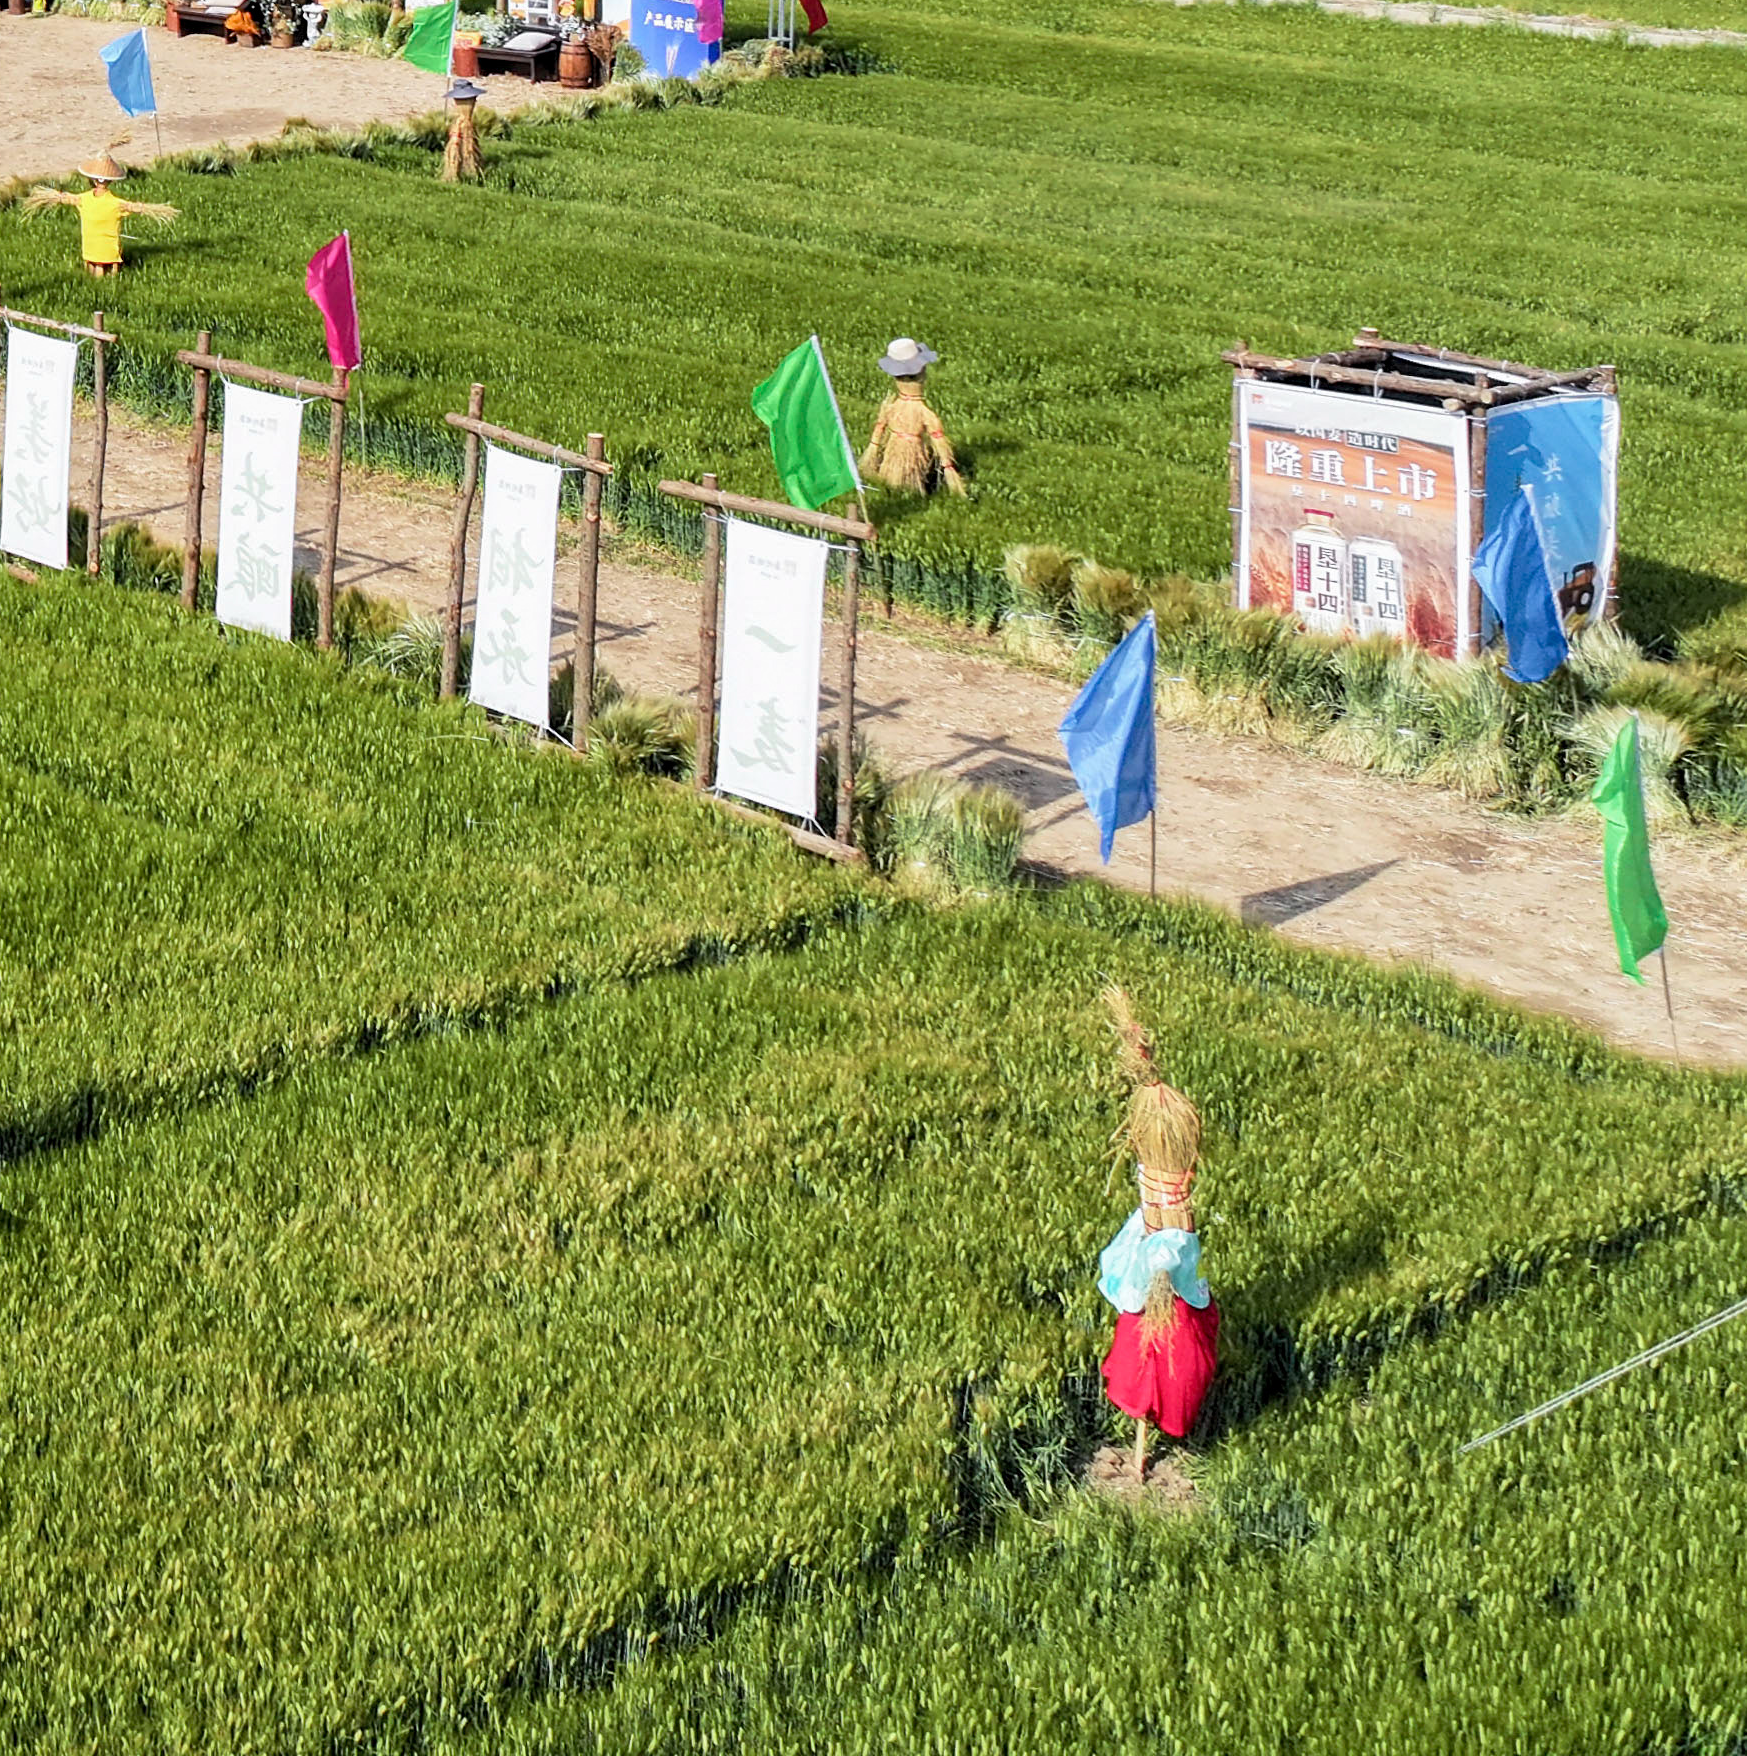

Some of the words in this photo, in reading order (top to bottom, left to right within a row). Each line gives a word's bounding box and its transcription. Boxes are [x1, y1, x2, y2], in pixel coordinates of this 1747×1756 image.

[1265, 439, 1438, 502] 隆重上市
[1316, 546, 1339, 614] 垦十四
[1375, 556, 1399, 620] 垦十四
